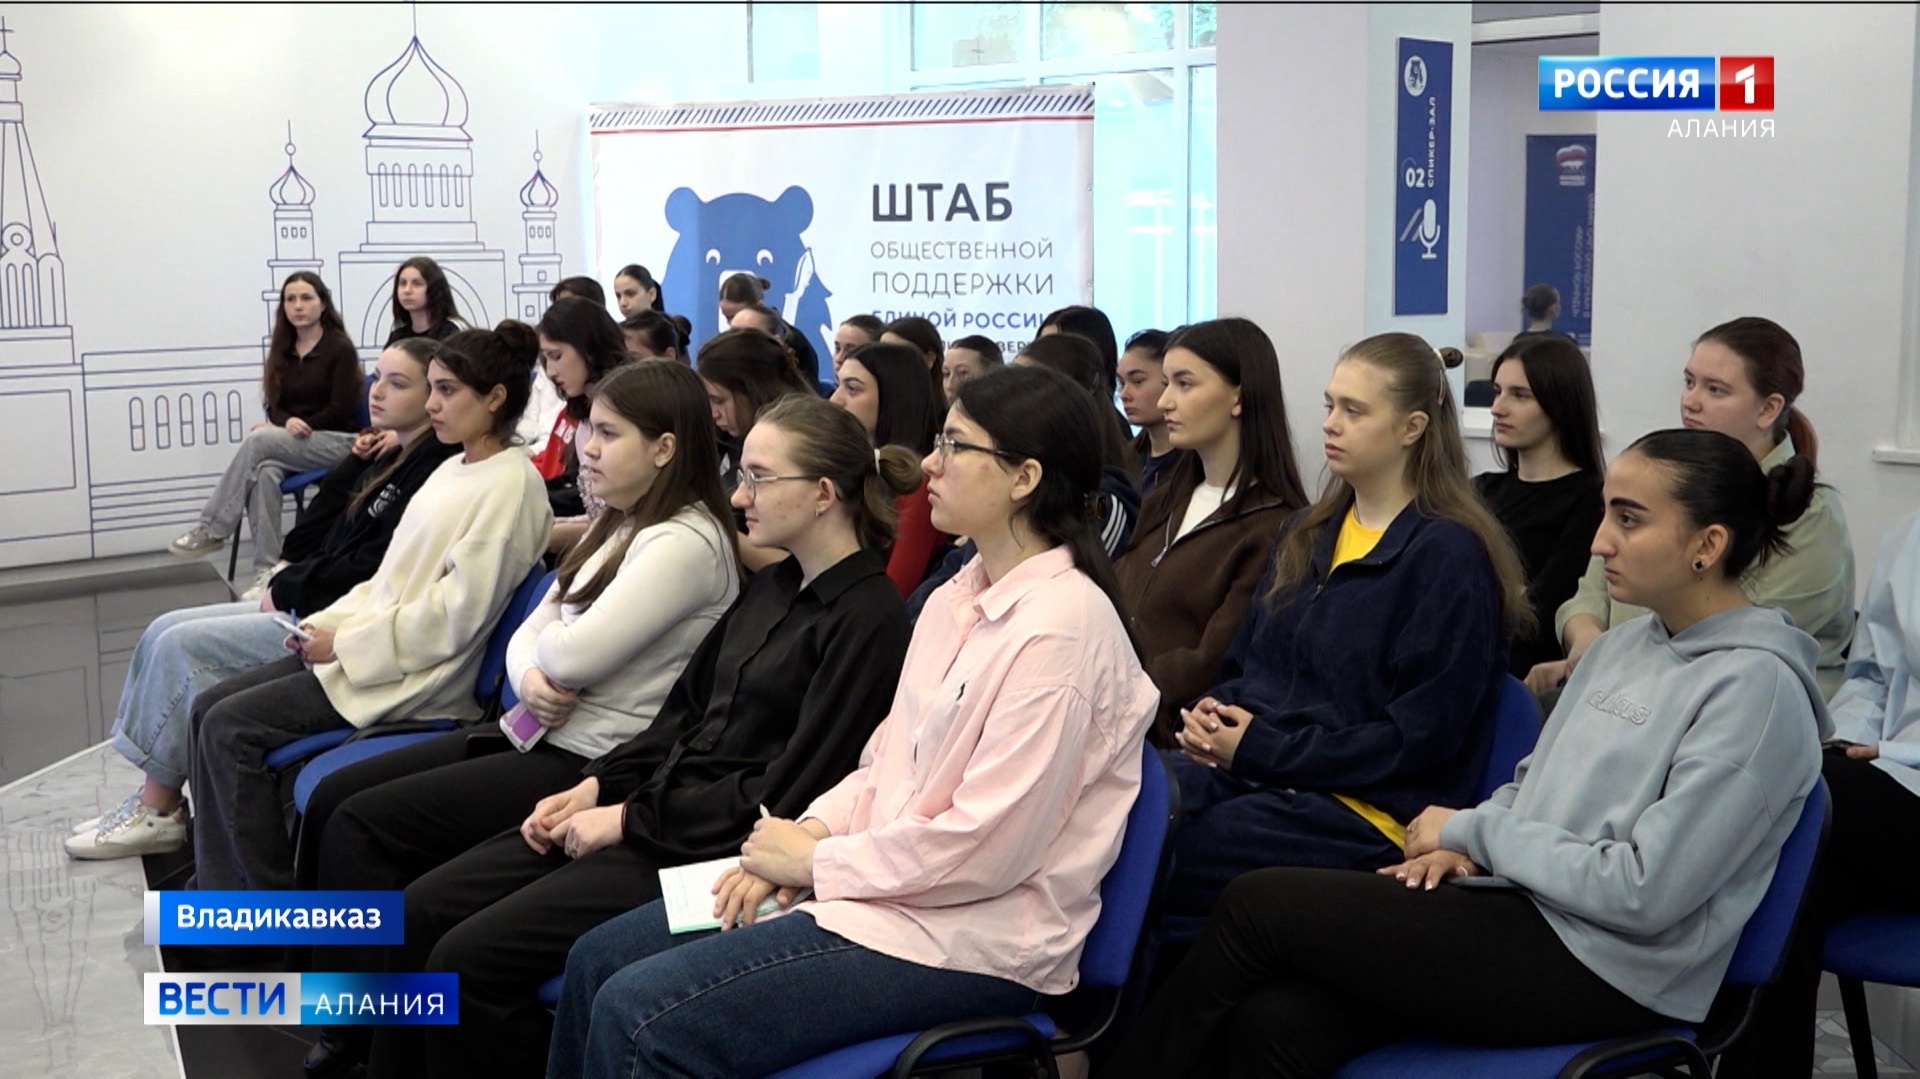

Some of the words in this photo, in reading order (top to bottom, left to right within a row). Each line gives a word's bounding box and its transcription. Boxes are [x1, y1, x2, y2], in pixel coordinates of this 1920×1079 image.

[1405, 166, 1426, 188] 02
[872, 181, 1013, 222] ШТАБ
[870, 236, 1053, 261] ОБЩЕСТВЕННОЙ
[872, 271, 1054, 299] ПОДДЕРЖКИ
